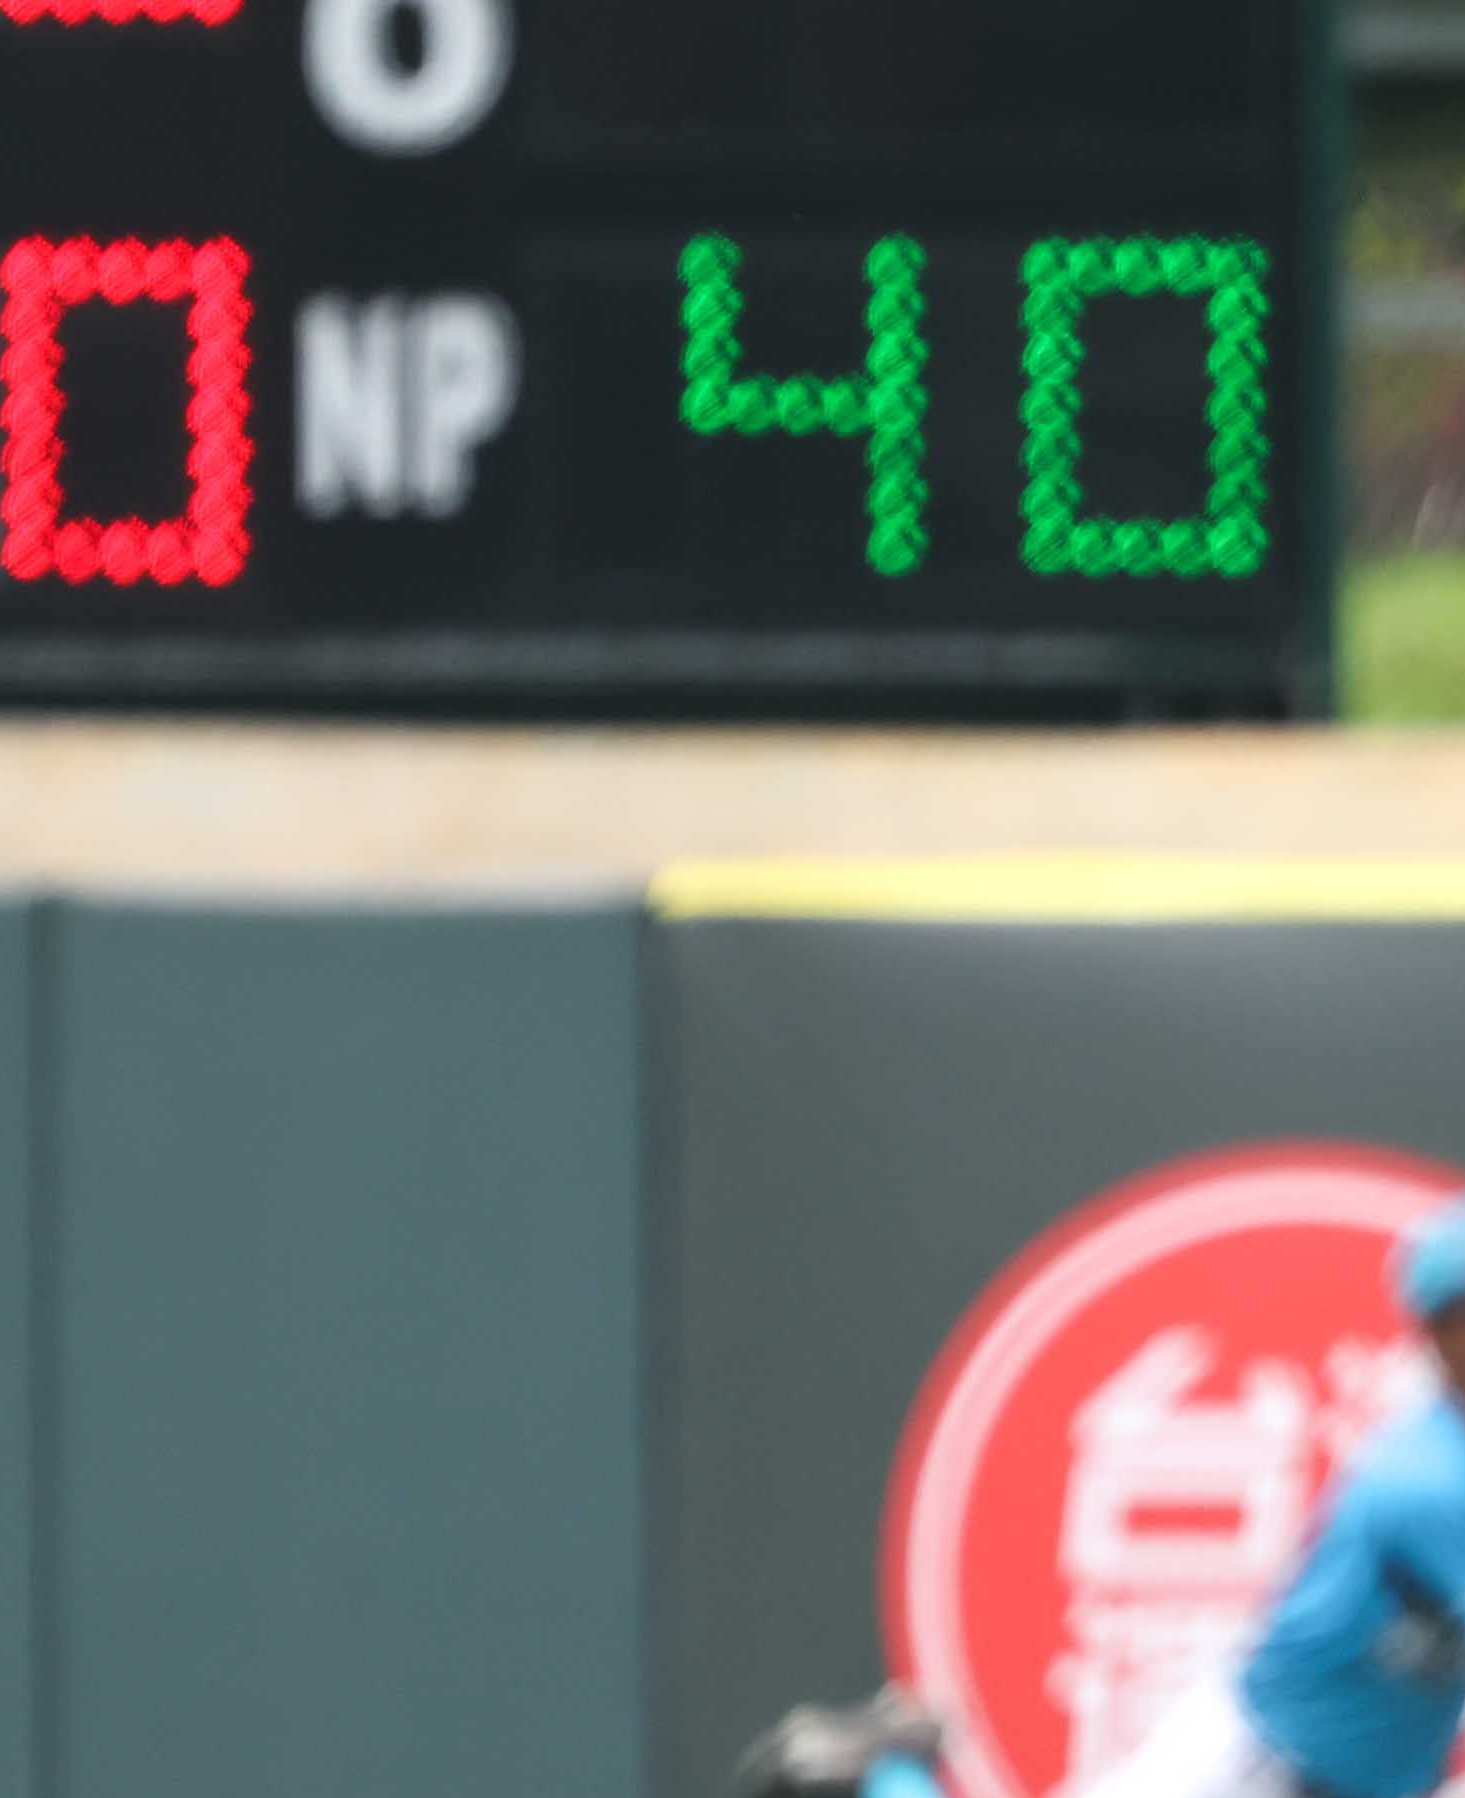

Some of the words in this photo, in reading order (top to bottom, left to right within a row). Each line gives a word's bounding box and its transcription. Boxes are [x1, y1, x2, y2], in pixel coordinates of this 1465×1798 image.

[0, 232, 256, 588] 0
[294, 288, 522, 522] NP
[677, 232, 1270, 578] 40
